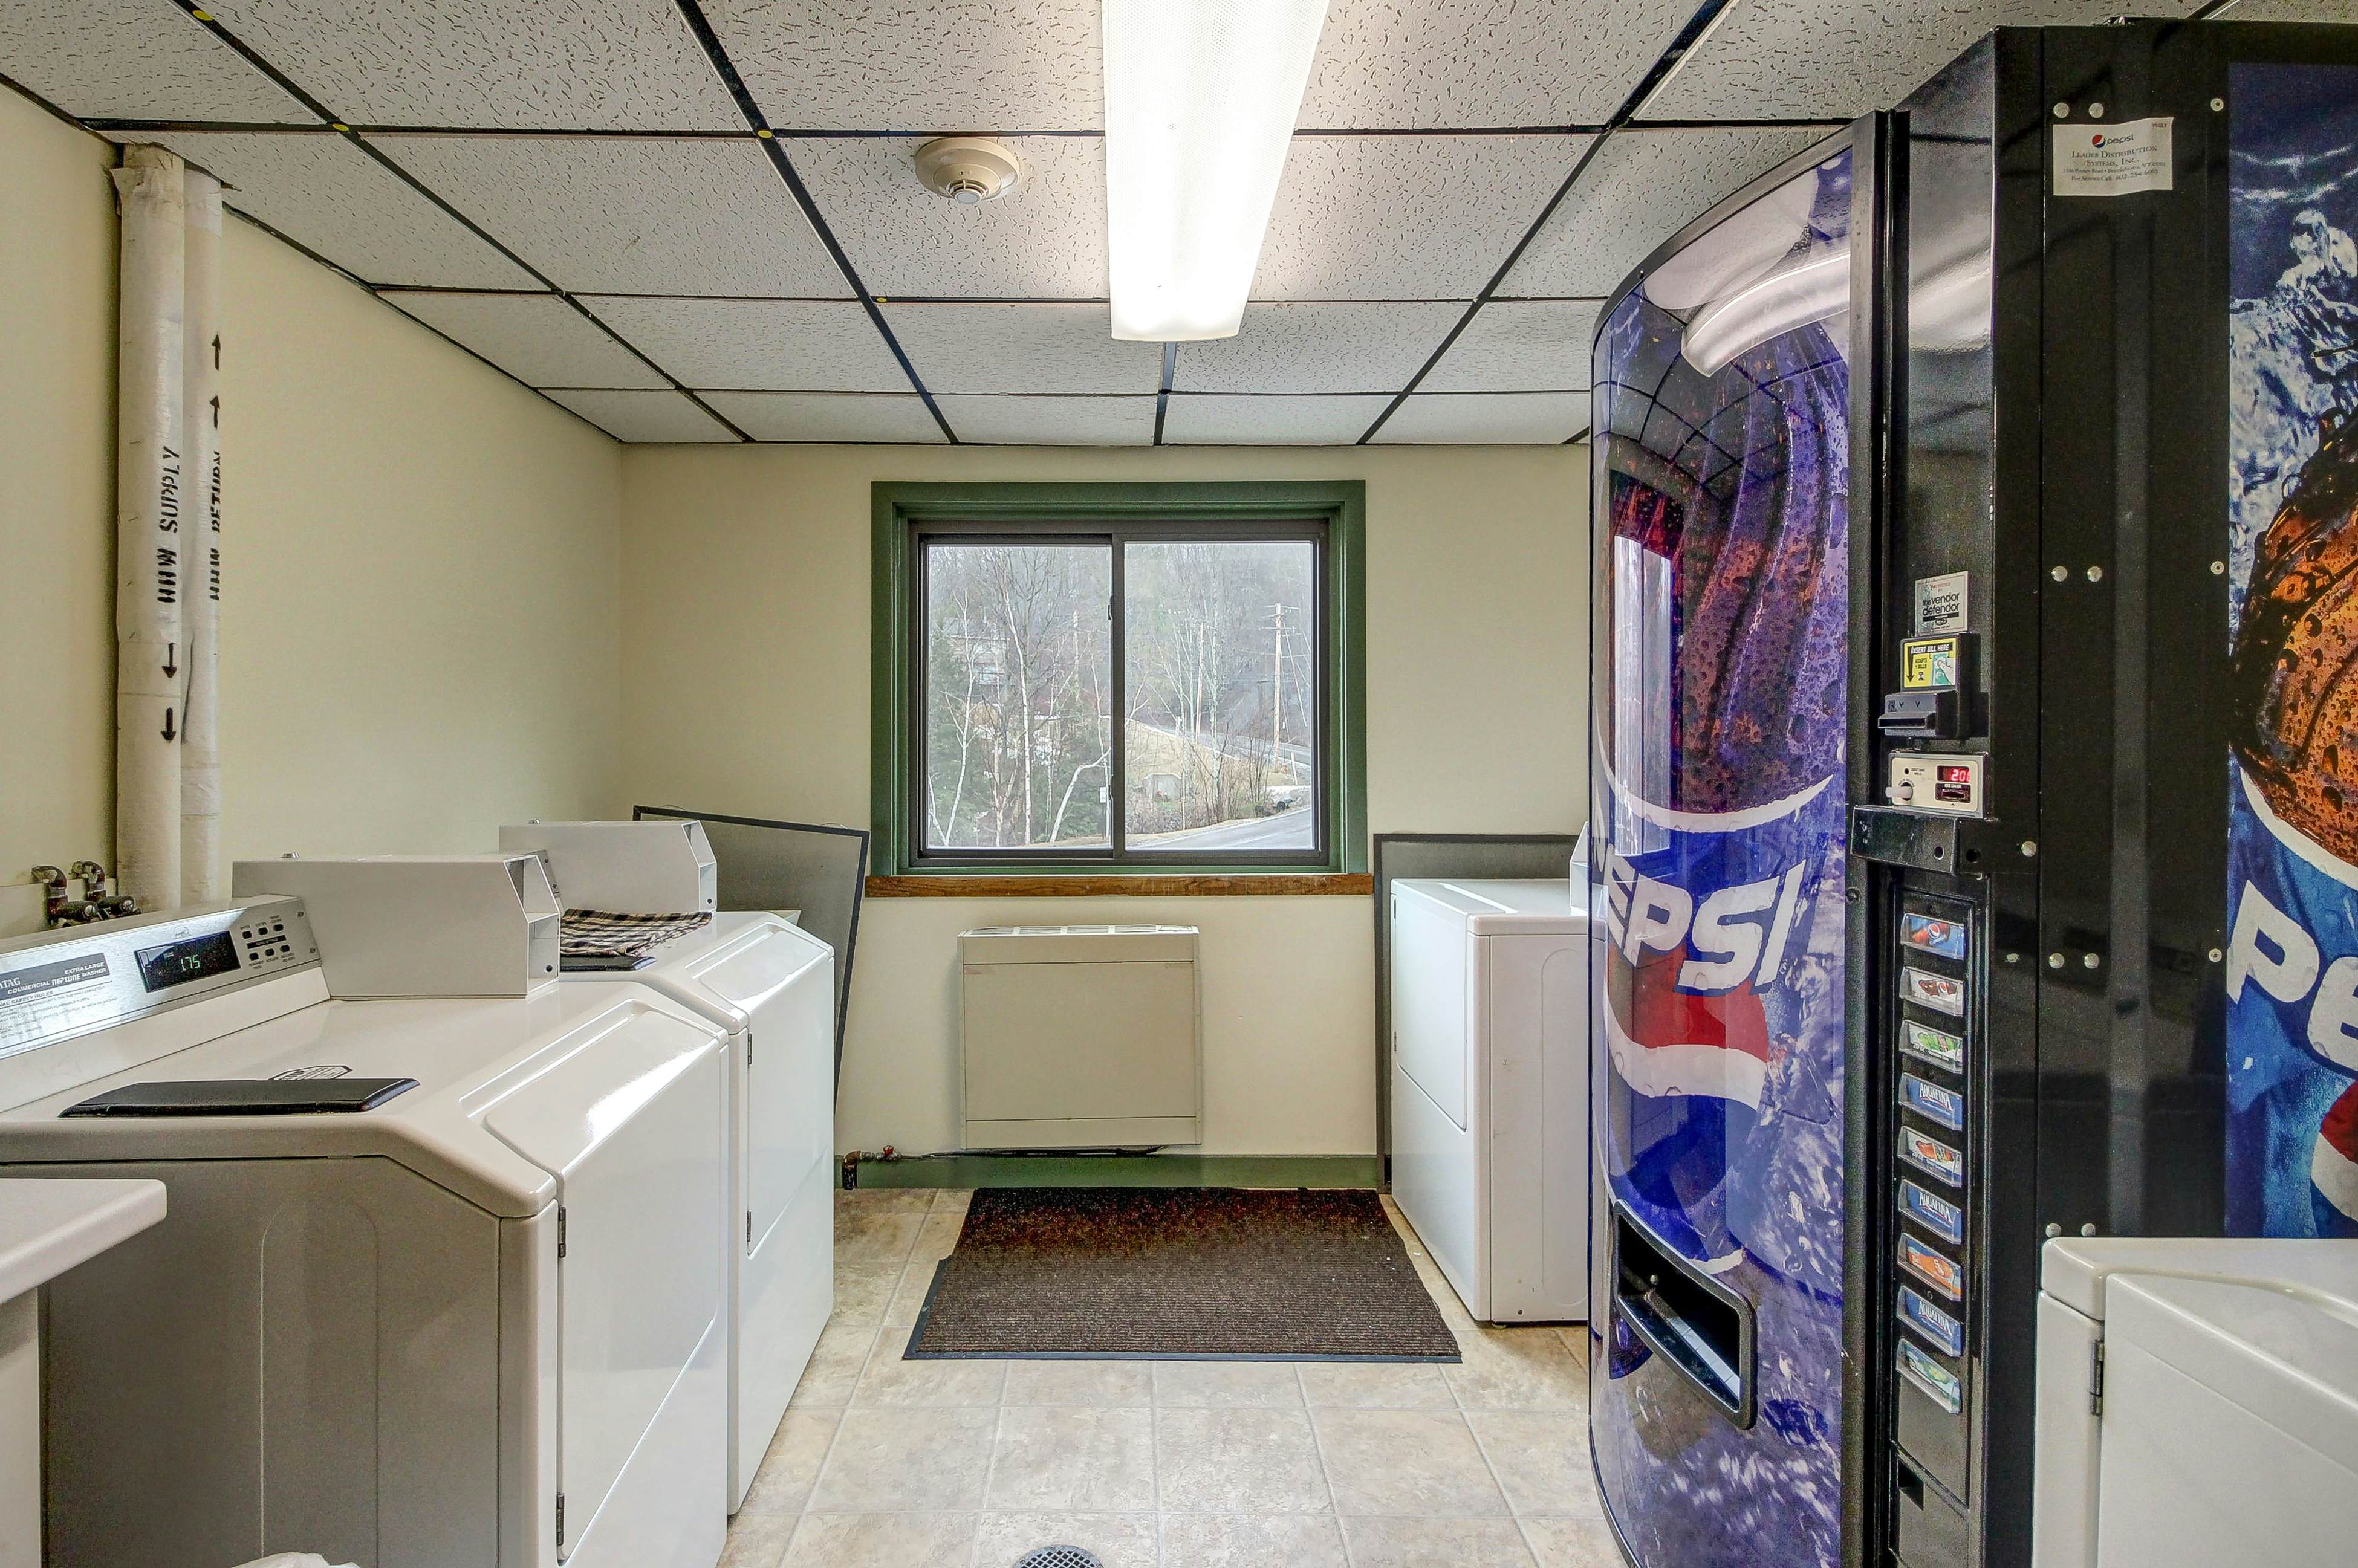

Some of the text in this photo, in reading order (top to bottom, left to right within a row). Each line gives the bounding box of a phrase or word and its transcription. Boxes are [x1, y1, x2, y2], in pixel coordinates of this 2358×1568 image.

[2107, 134, 2134, 145] pepsi
[158, 445, 180, 534] SUPPLY
[1931, 592, 1960, 604] vendor
[1923, 602, 1960, 616] defendor
[1911, 646, 1927, 654] INSERT
[64, 961, 105, 975] EXTRA LARGE
[0, 977, 21, 990] TAG
[7, 967, 107, 994] COMMERCIAL NEPTUNE WASHER
[11, 995, 34, 1004] SAFETY
[34, 990, 54, 999] RULES
[1919, 1082, 1955, 1112] AQUAFINA
[1919, 1191, 1955, 1224] AQUAFINA
[1918, 1300, 1954, 1338] AQUAFINA
